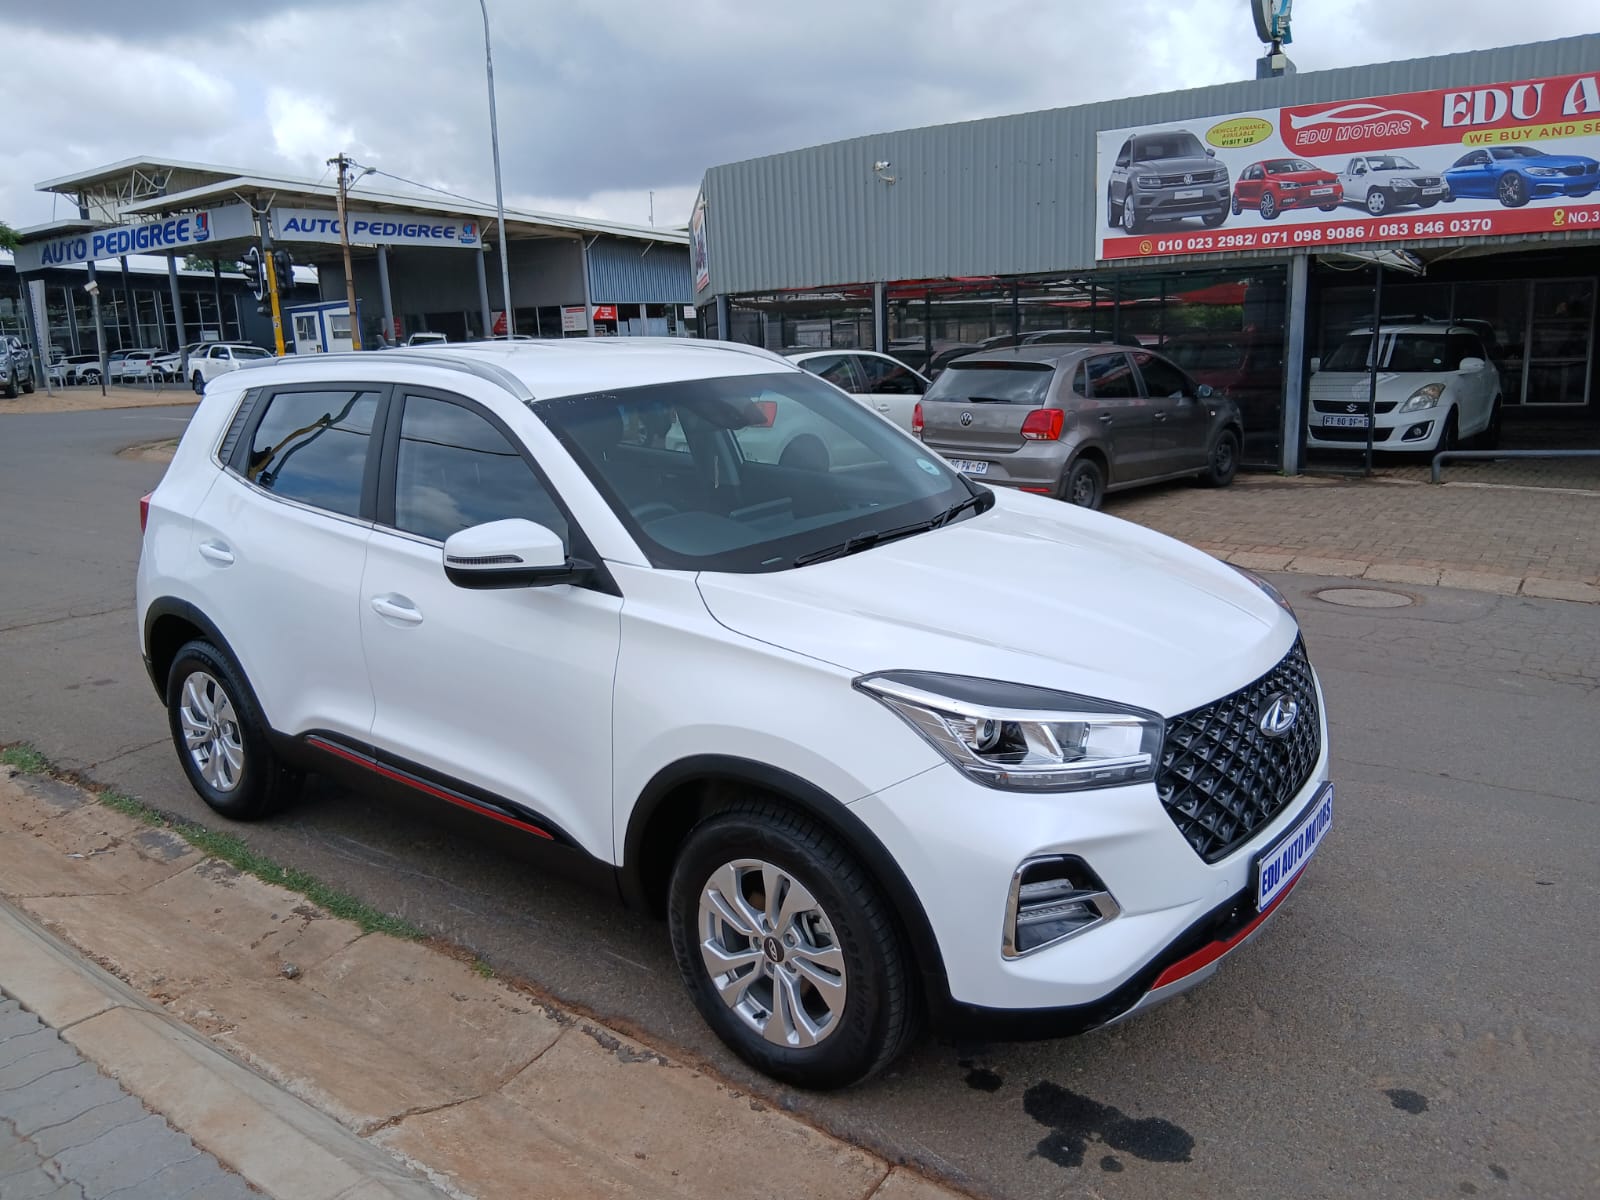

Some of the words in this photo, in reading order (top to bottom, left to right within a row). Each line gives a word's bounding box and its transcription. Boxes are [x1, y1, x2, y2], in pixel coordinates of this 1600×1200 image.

[1442, 83, 1546, 128] EDU
[1212, 126, 1238, 134] VEHICLE
[1239, 123, 1266, 131] FINANCE
[1222, 130, 1255, 138] AVAILABLE
[1295, 128, 1332, 145] EDU
[1335, 120, 1412, 141] MOTORS
[1469, 133, 1493, 144] WE
[1500, 129, 1533, 141] BUY
[1539, 123, 1575, 138] AND
[1222, 138, 1242, 146] VISIT
[353, 221, 456, 239] PEDIGREE
[1157, 239, 1183, 252] 010
[1187, 237, 1213, 249] 023
[1262, 231, 1288, 244] 071
[1294, 229, 1322, 242] 098
[1326, 225, 1365, 239] 9086
[1379, 222, 1409, 236] 083
[1414, 220, 1445, 234] 846
[1450, 218, 1493, 232] 0370
[41, 238, 87, 265] AUTO
[93, 218, 190, 257] PEDIGREE
[976, 462, 987, 473] GP
[1262, 857, 1281, 897] EDU
[1282, 833, 1304, 878] AUTO
[1305, 797, 1331, 852] MOTORS
